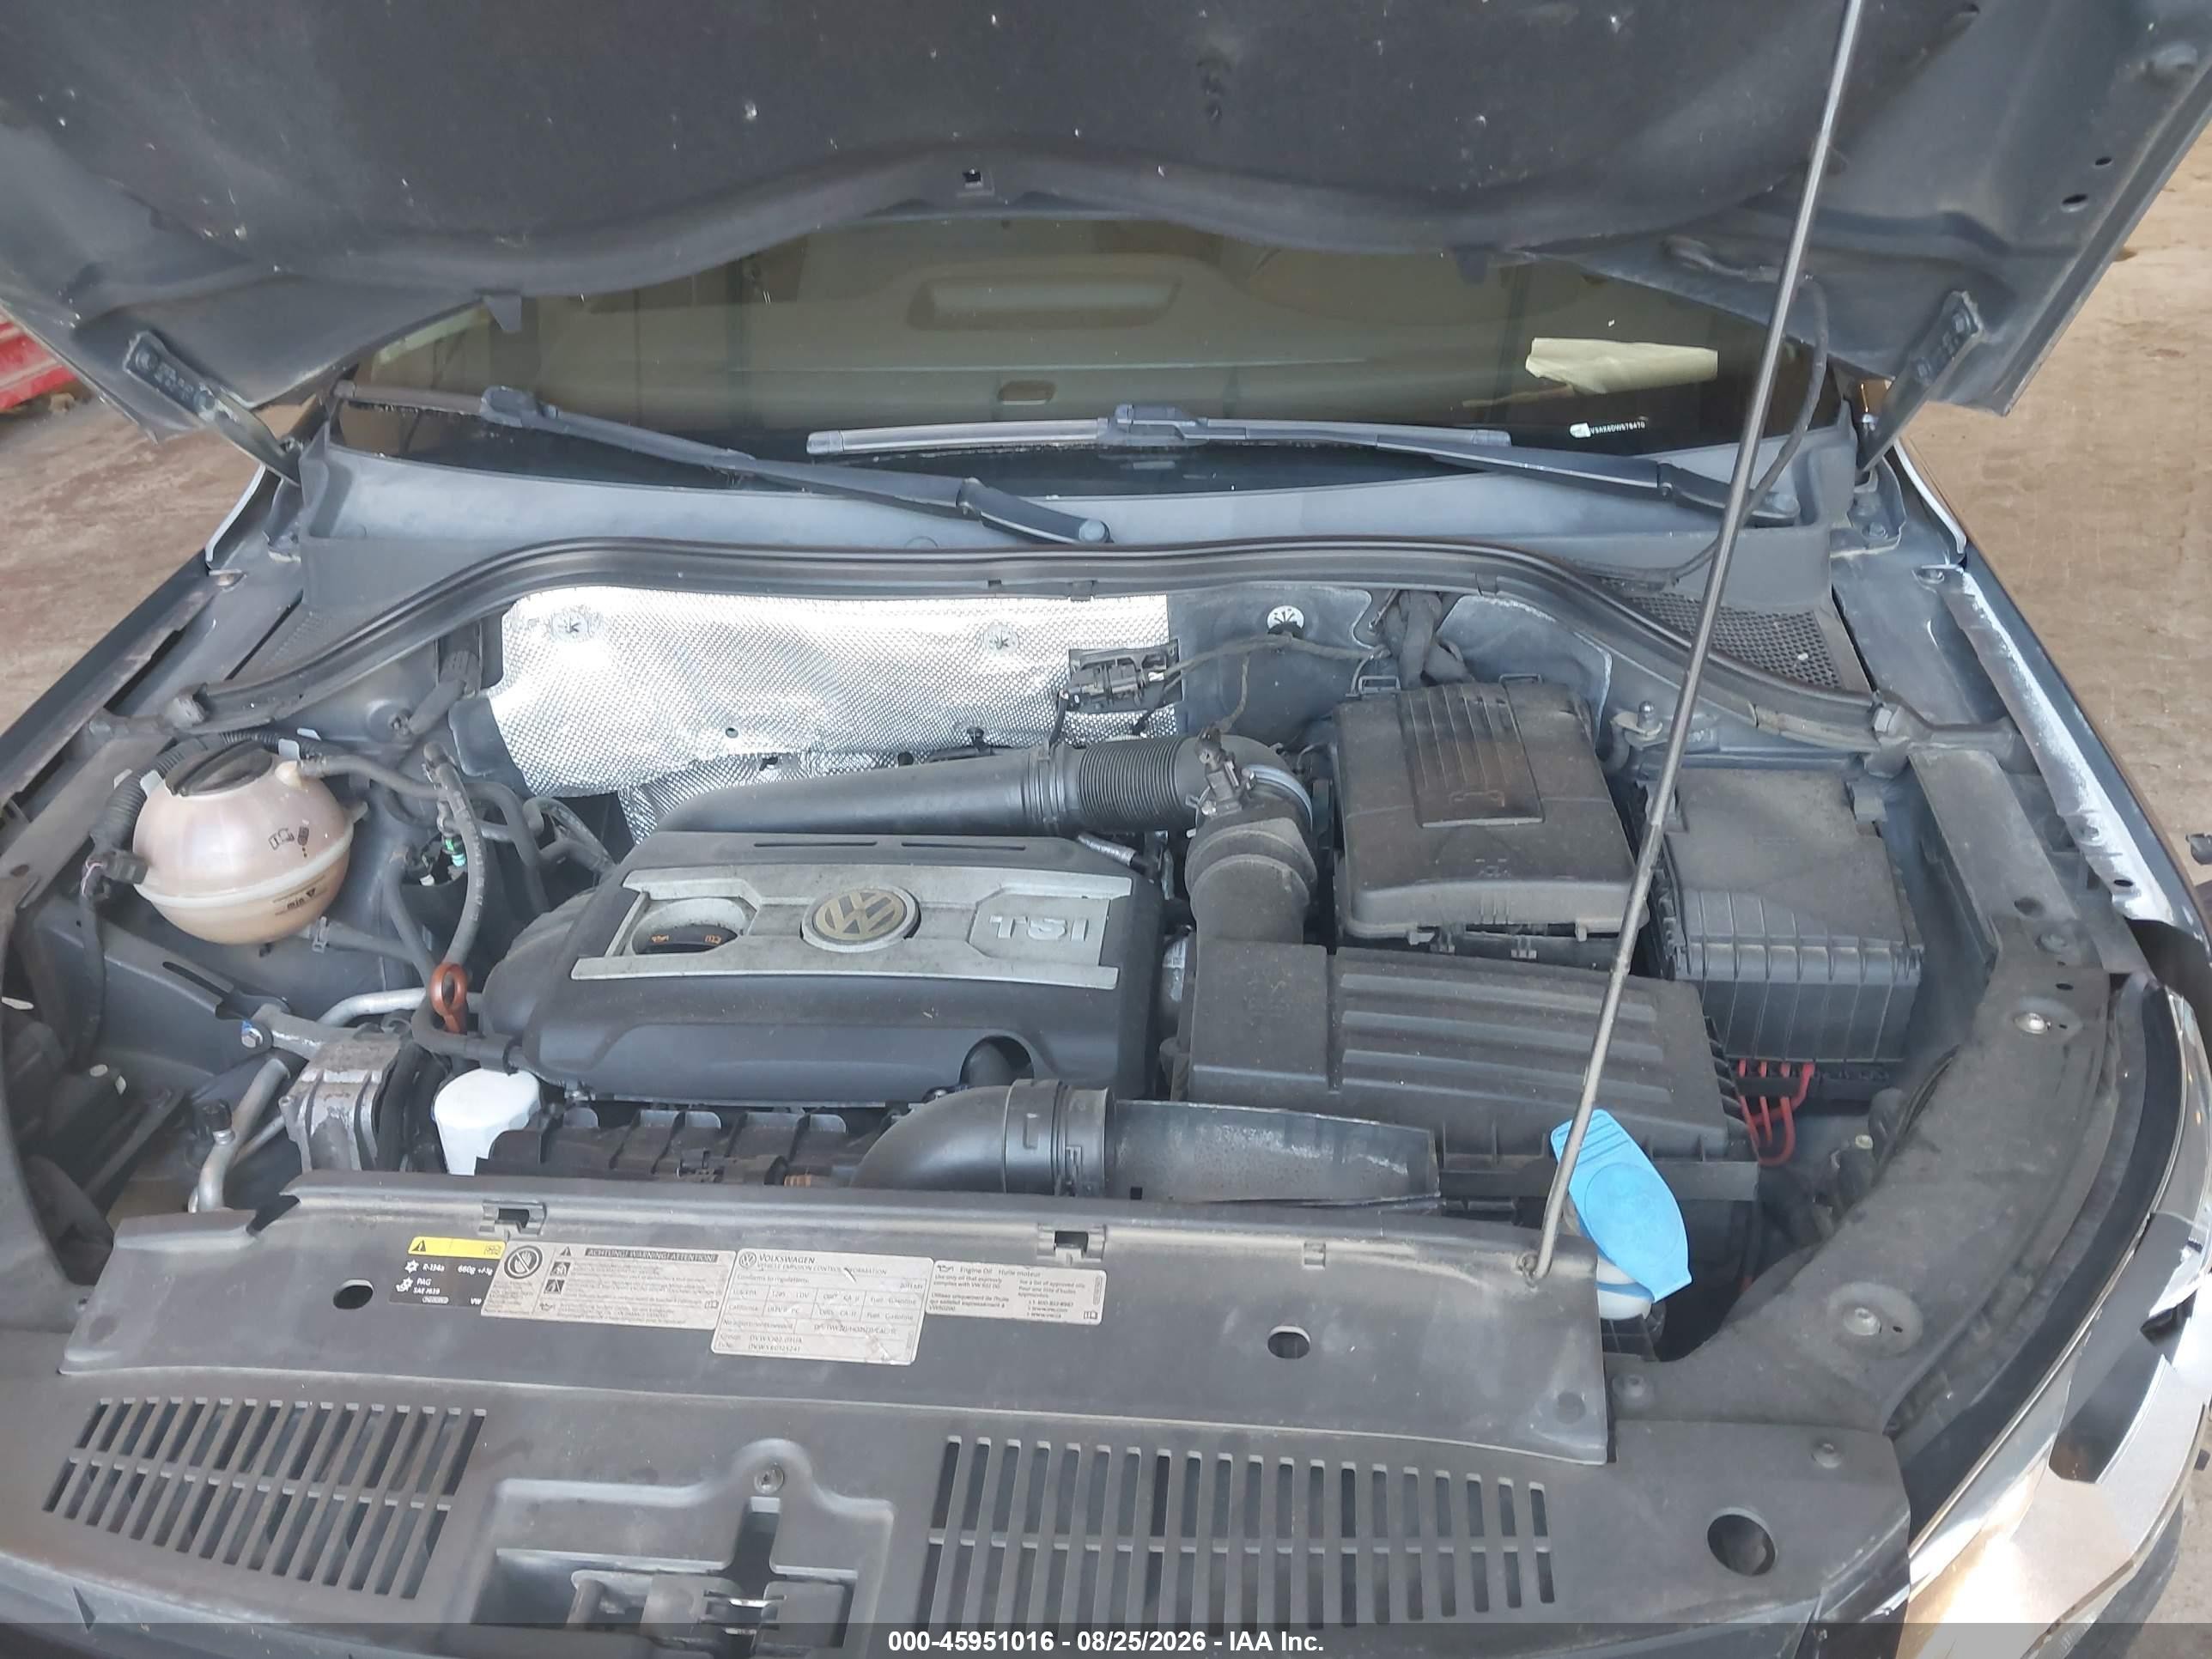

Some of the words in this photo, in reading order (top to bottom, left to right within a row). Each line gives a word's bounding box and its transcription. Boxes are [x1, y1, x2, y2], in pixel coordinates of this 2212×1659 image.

[989, 915, 1089, 942] TSI
[630, 1250, 669, 1260] WARNING!
[670, 1253, 715, 1262] ATTENTION!
[759, 1254, 815, 1264] VOLKSWAGEN
